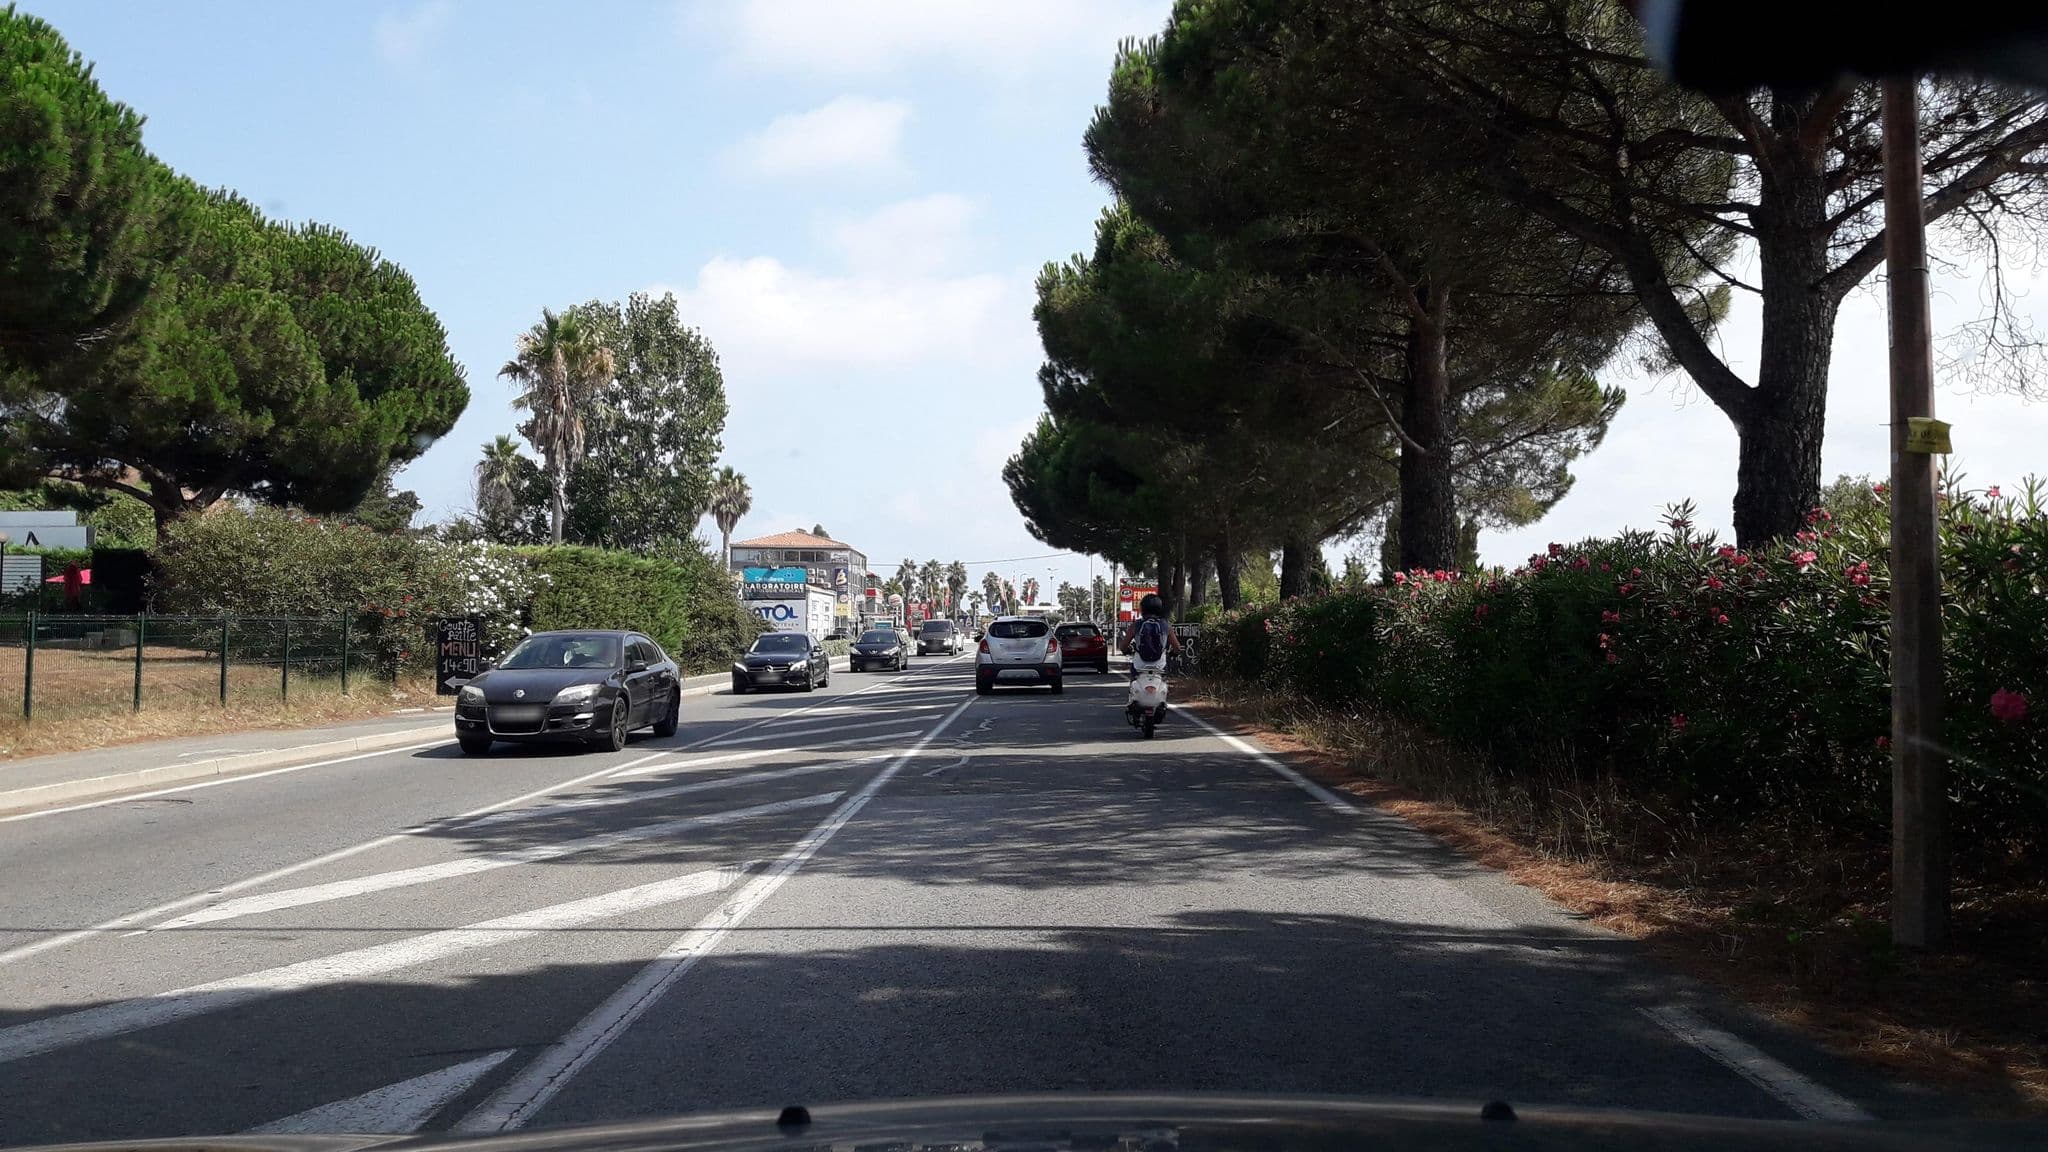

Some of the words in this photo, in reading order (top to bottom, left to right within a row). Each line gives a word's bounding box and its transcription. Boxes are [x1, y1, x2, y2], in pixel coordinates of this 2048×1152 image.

[753, 604, 799, 621] ATOL
[439, 618, 475, 632] Courte
[441, 641, 476, 657] MENU
